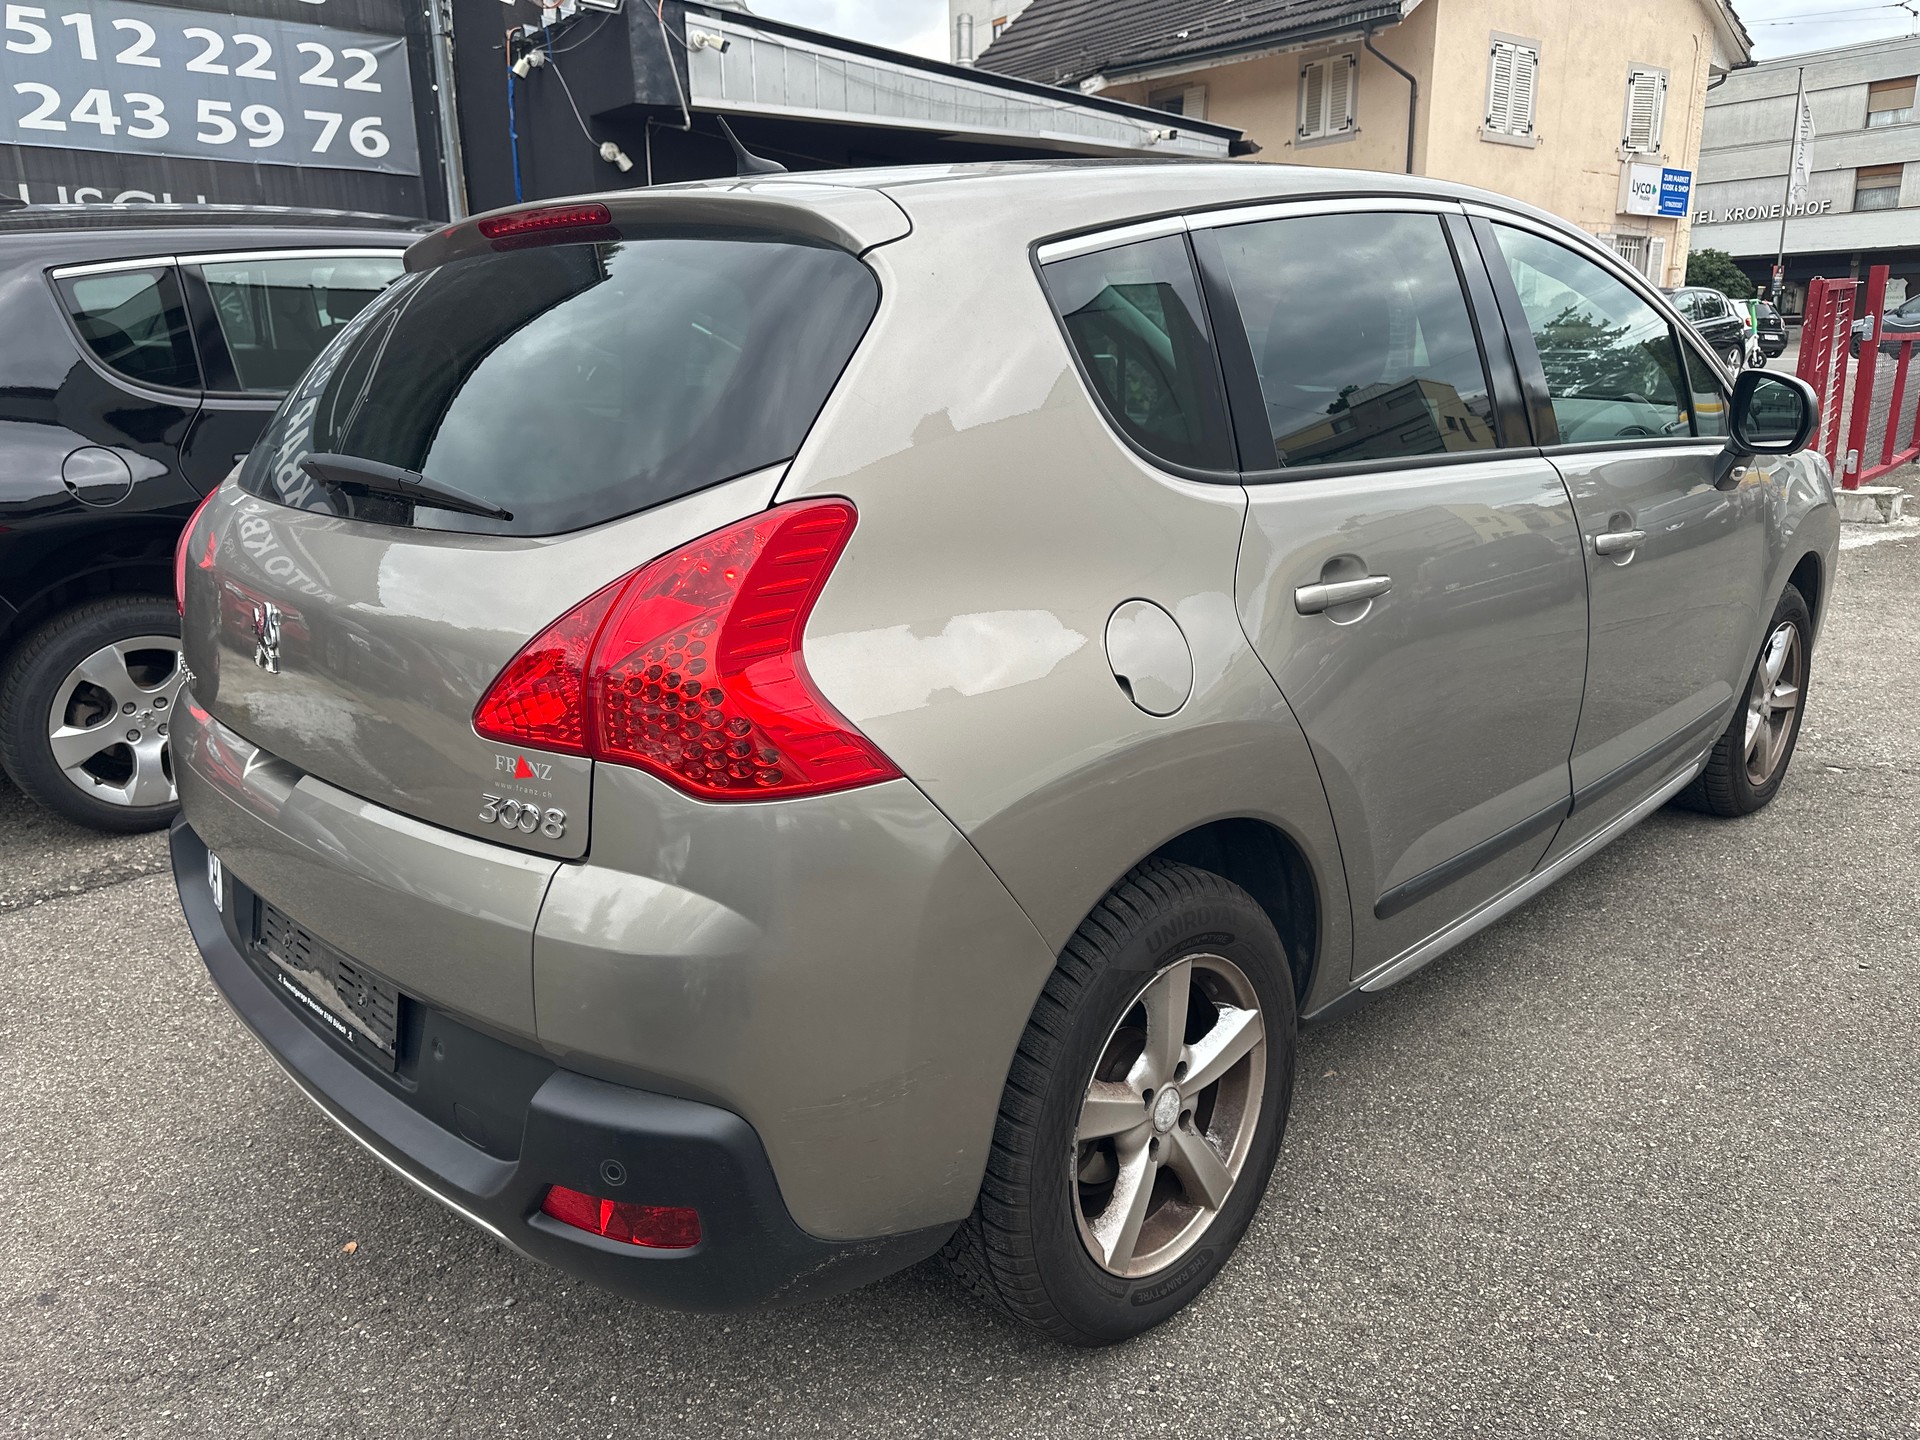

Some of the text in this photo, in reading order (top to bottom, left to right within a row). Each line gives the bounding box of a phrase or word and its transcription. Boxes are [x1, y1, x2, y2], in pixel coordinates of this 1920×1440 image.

[5, 3, 383, 94] 512 22 22
[12, 81, 391, 159] 243 59 76
[1632, 179, 1652, 196] Lyca
[1692, 200, 1832, 224] TEL KRONENHOF
[495, 781, 552, 799] www.franz.ch
[478, 793, 566, 839] 3008
